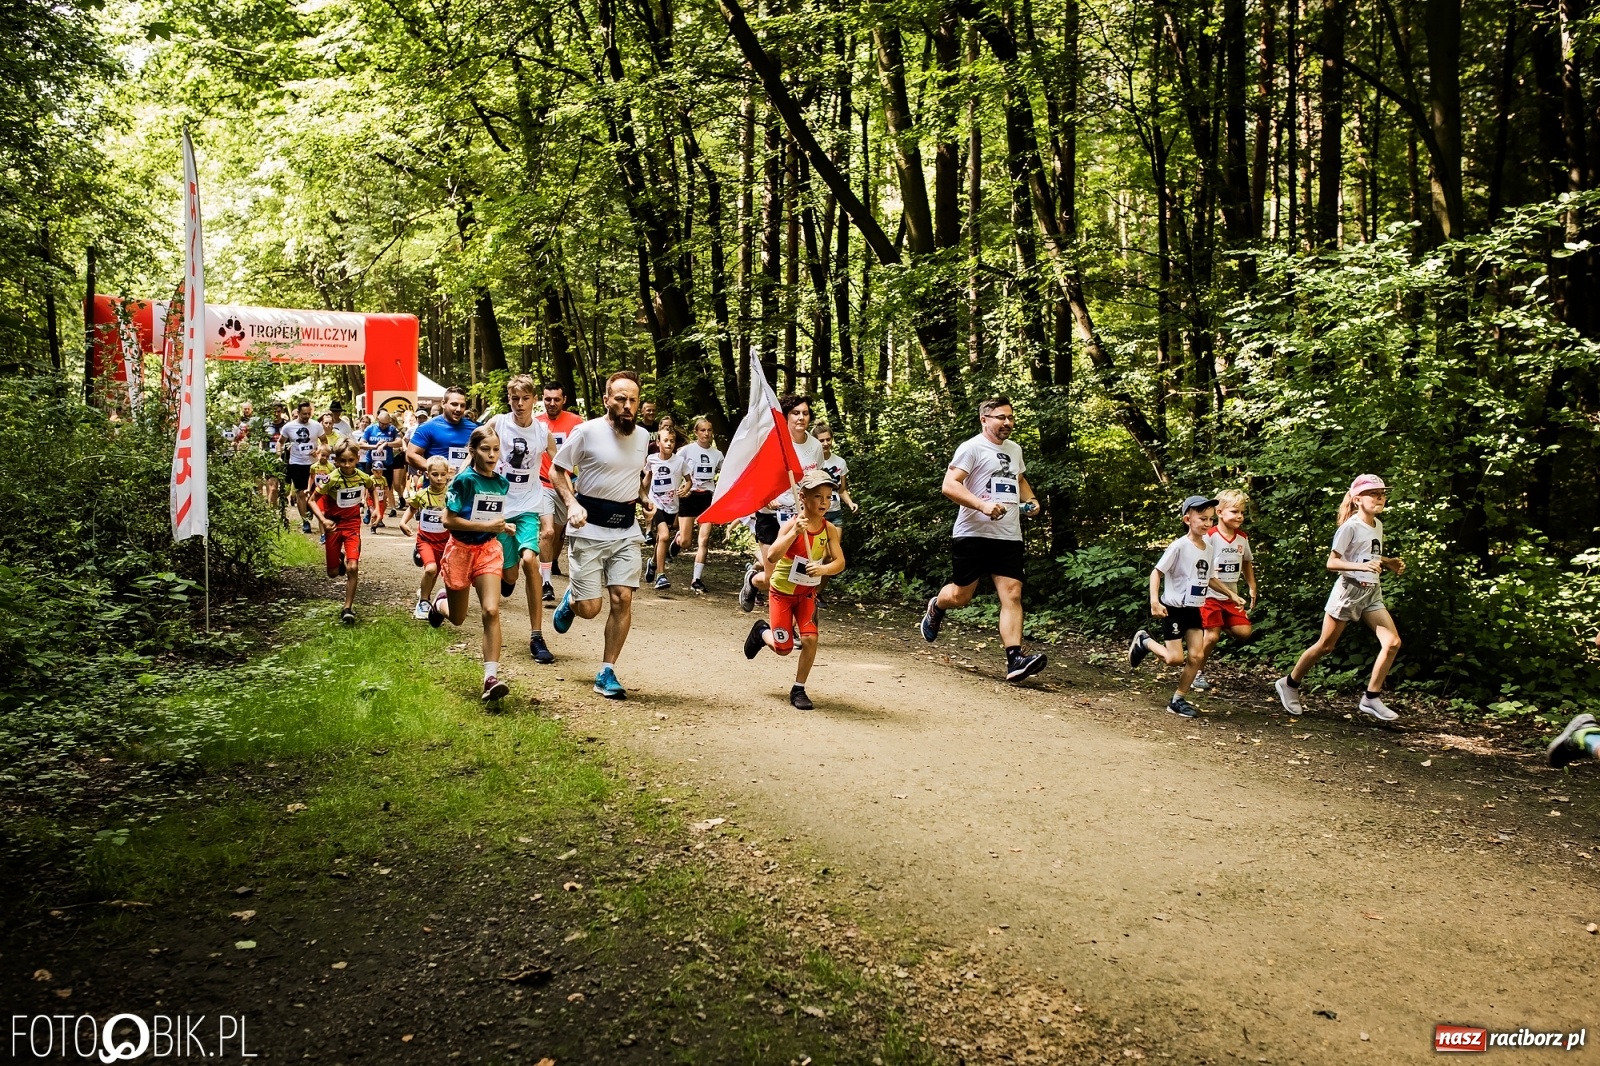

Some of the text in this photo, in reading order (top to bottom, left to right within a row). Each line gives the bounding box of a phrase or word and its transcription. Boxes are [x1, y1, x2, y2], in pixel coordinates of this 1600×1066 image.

[1004, 484, 1011, 492] 2
[346, 491, 357, 499] 47
[485, 501, 498, 511] 75
[1224, 564, 1236, 572] 68
[1200, 587, 1206, 595] 4
[777, 631, 785, 640] B
